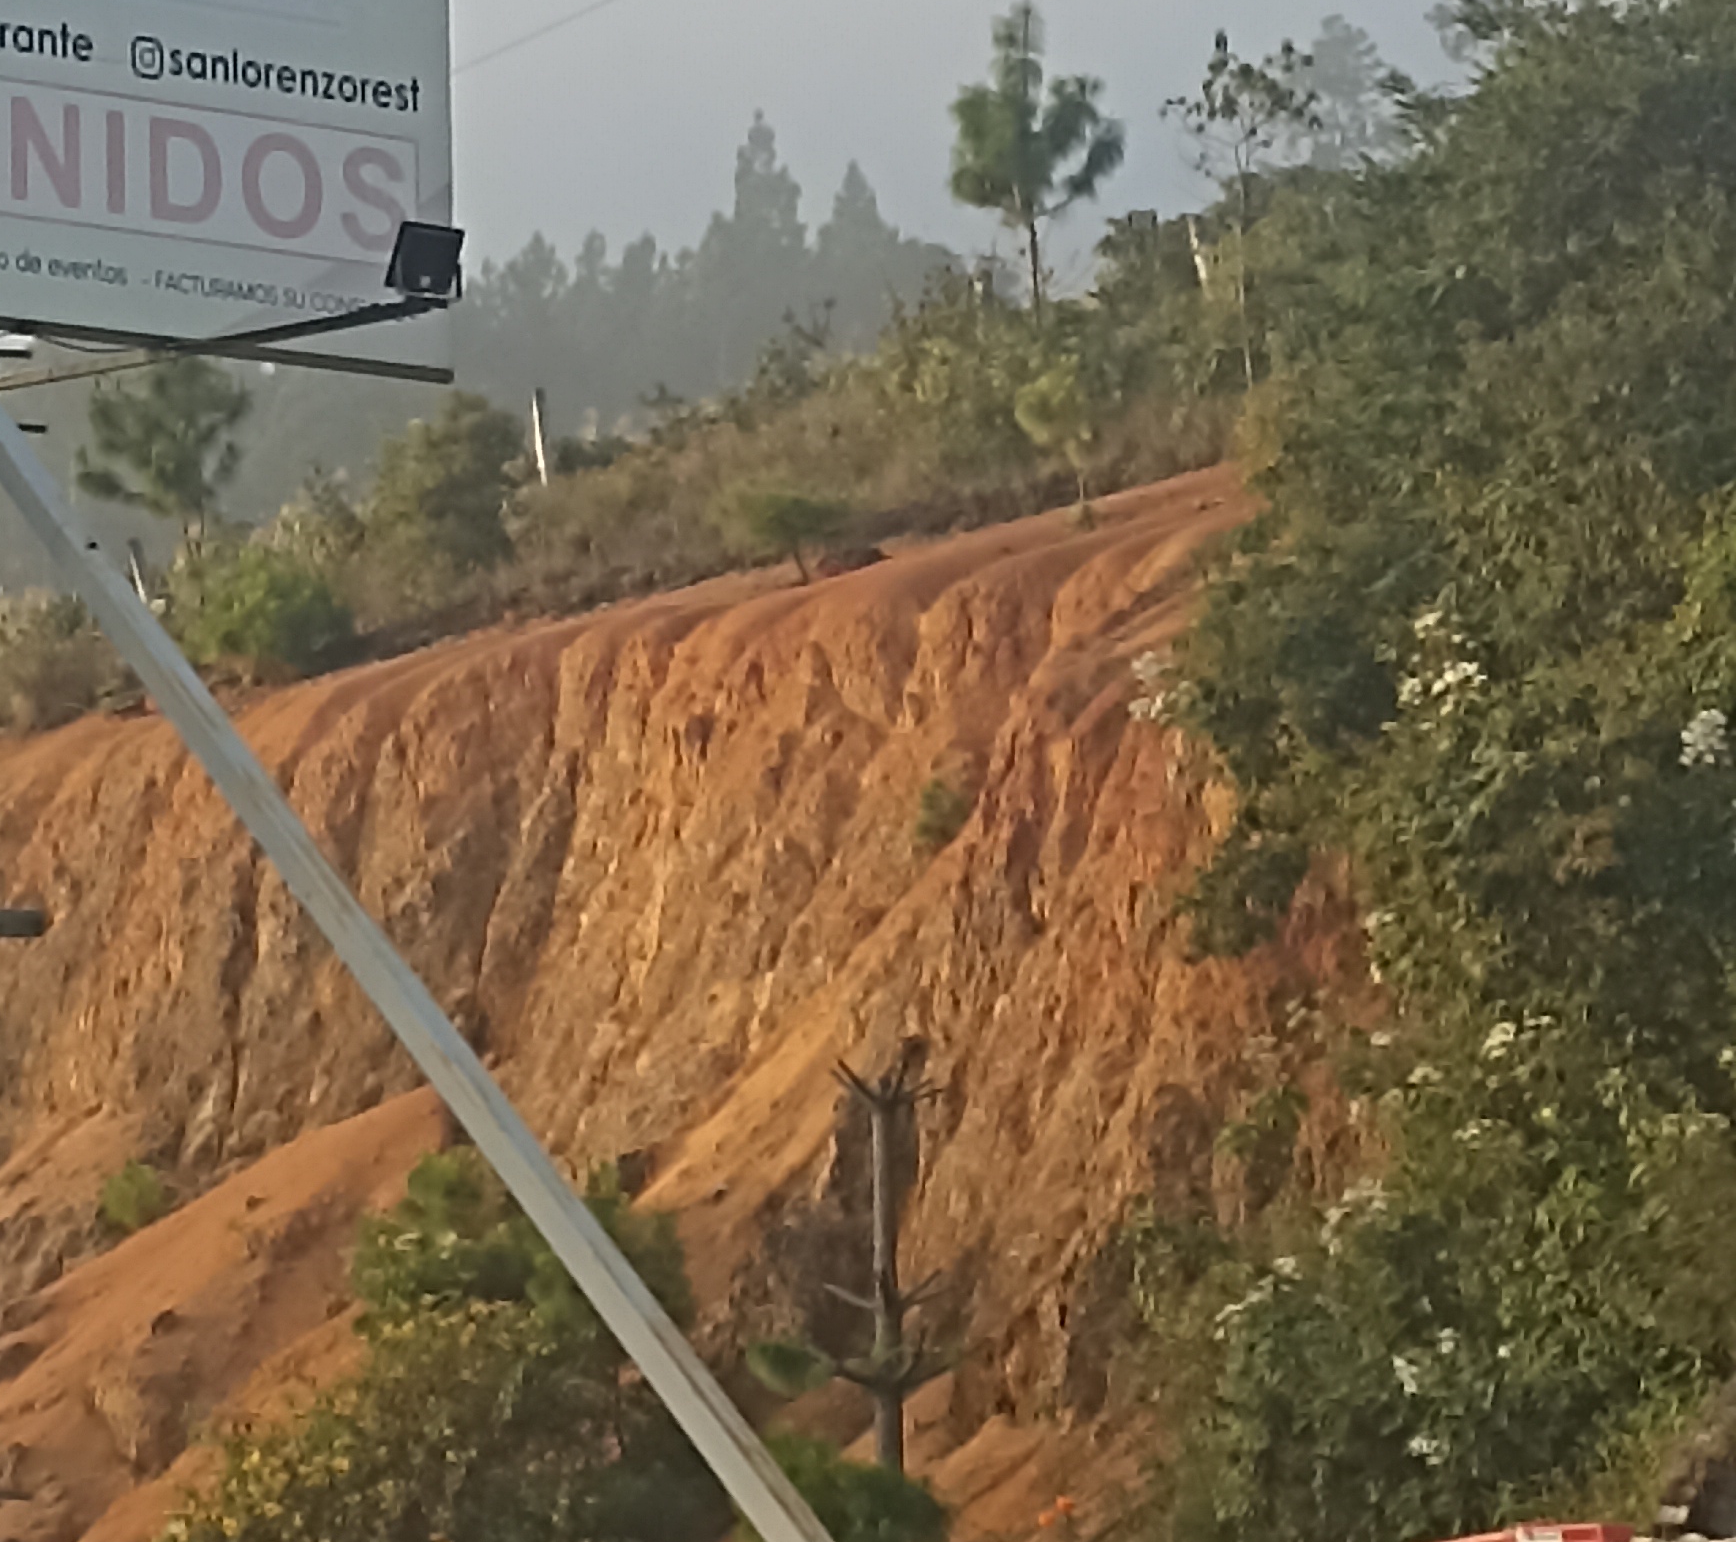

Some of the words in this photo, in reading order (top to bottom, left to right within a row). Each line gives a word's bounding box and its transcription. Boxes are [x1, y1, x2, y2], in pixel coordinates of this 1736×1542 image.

[167, 48, 421, 112] sanlorenzorest
[15, 247, 41, 275] de
[48, 258, 127, 287] eventos
